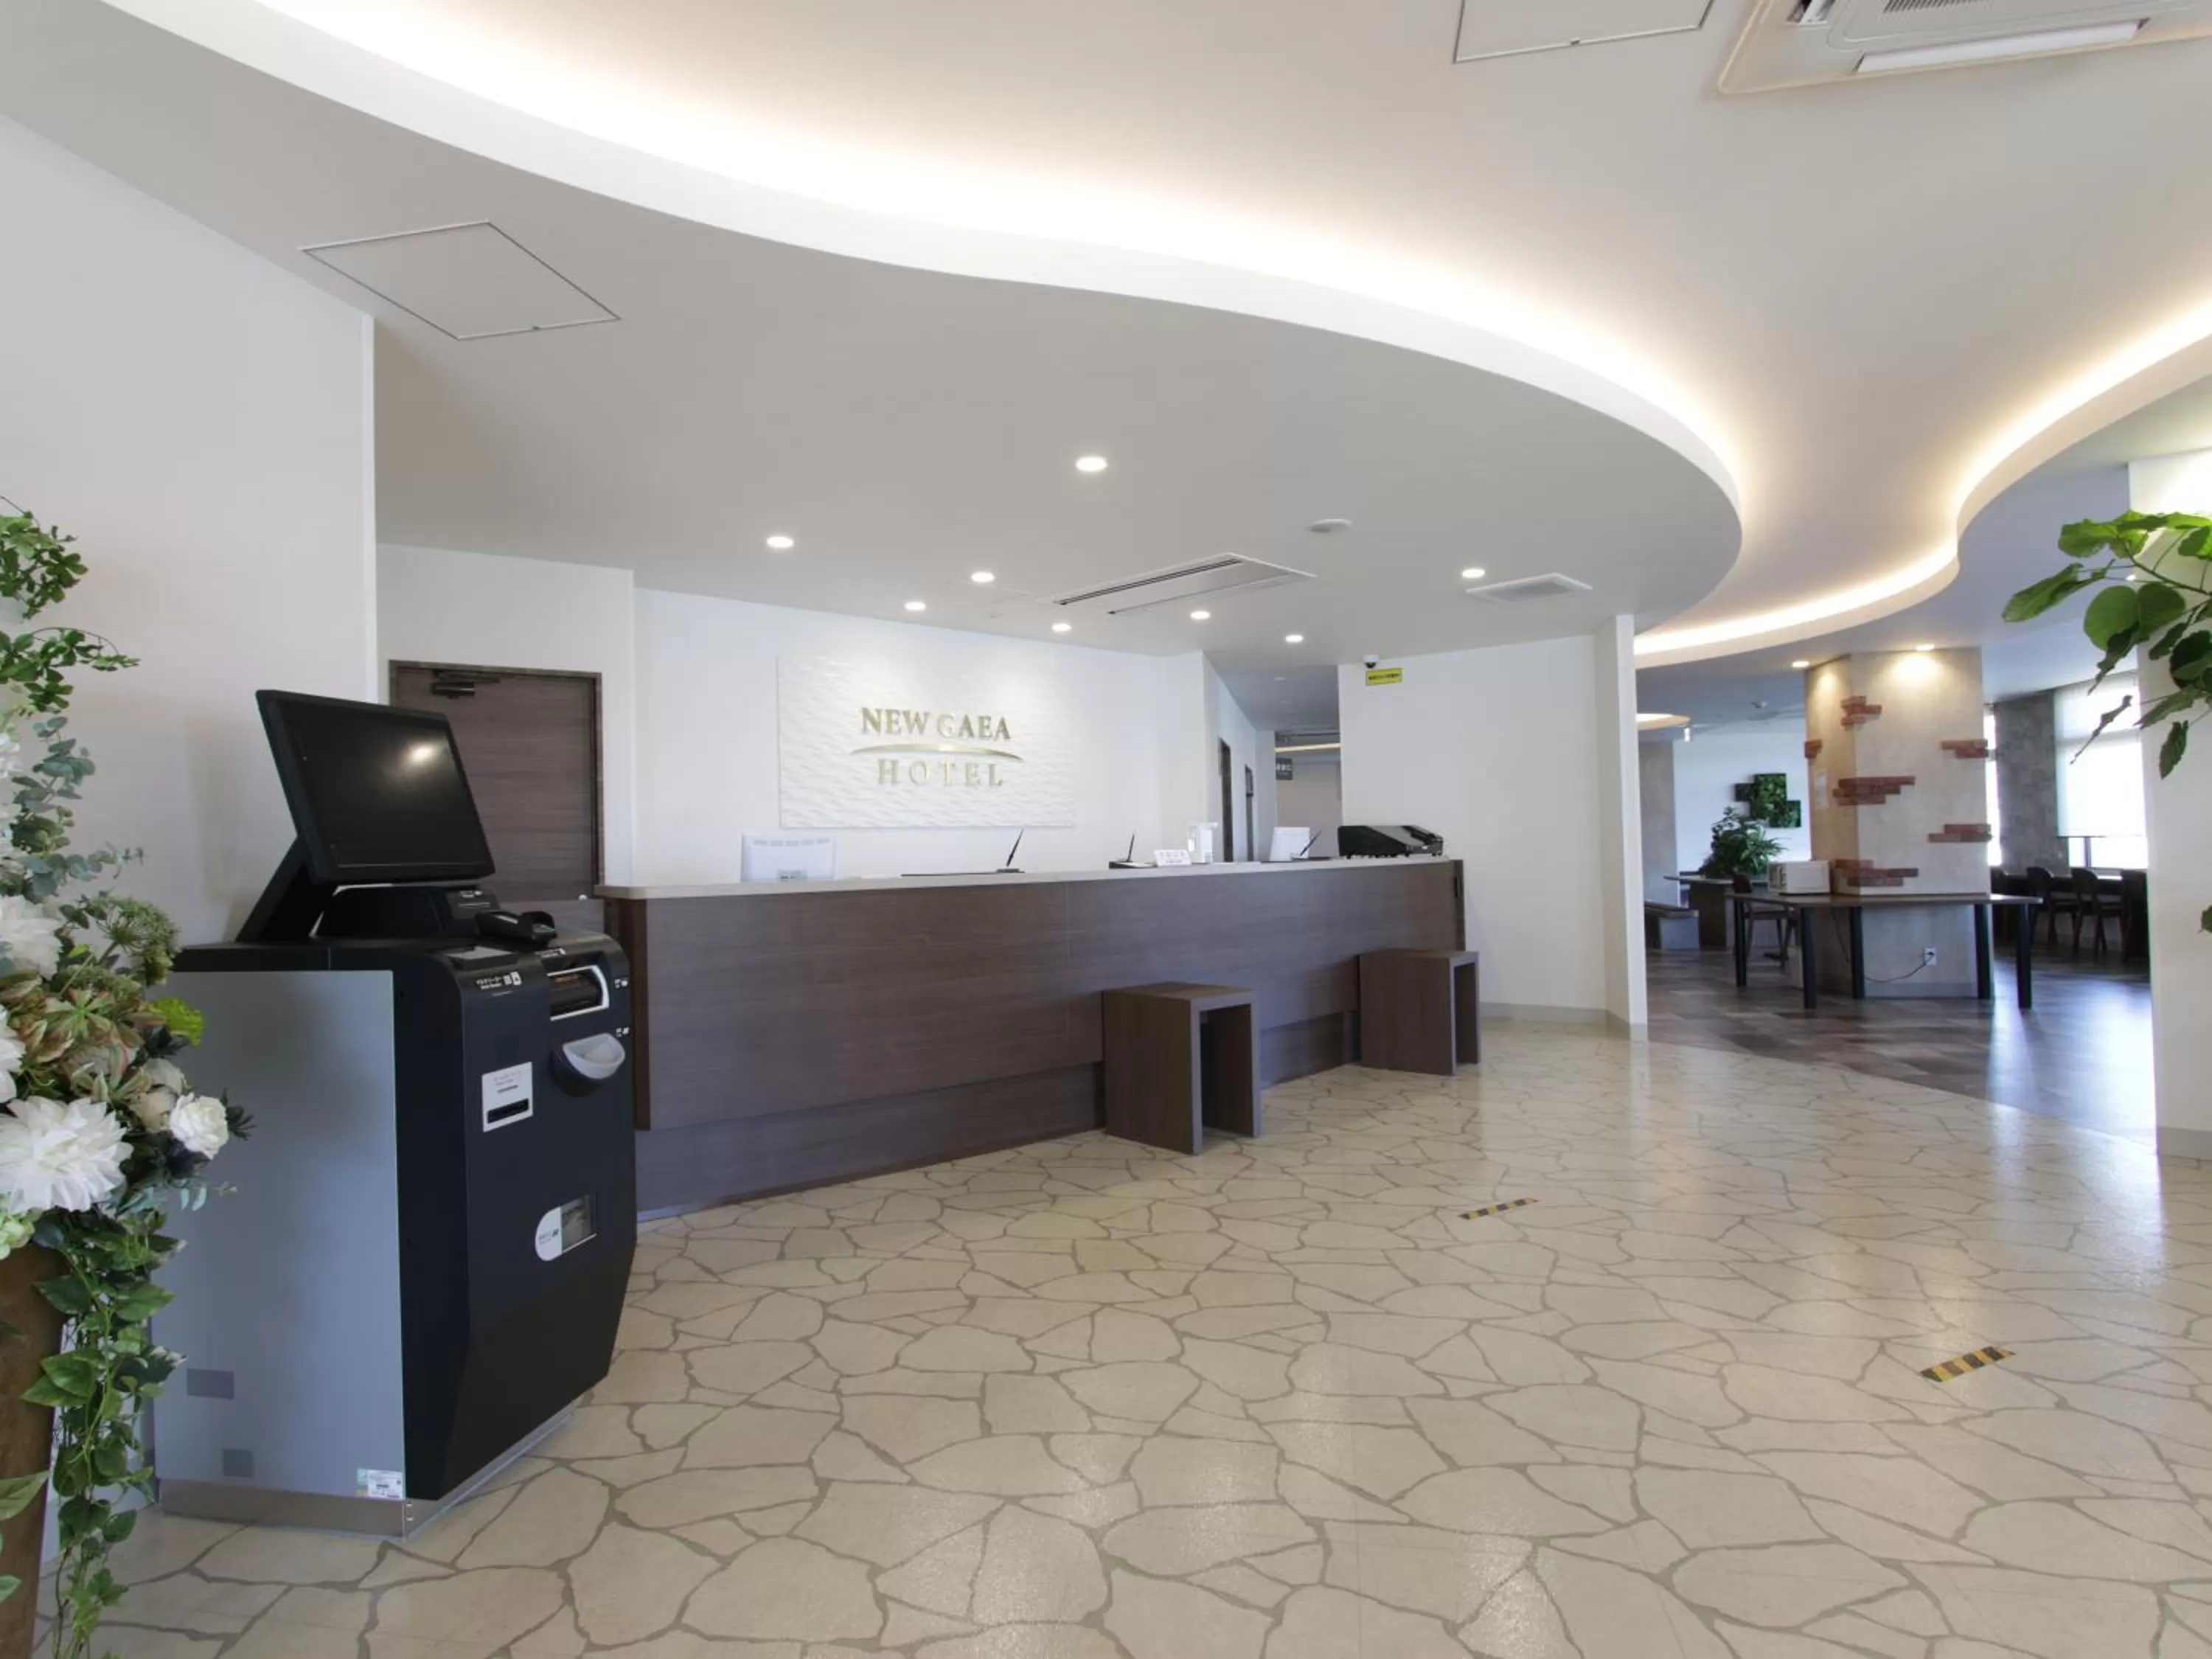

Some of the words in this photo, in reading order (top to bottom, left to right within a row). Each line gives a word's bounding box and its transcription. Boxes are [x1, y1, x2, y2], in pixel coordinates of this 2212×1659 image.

[861, 707, 930, 736] NEW
[937, 713, 1012, 740] GAEA
[877, 758, 1004, 787] HOTEL
